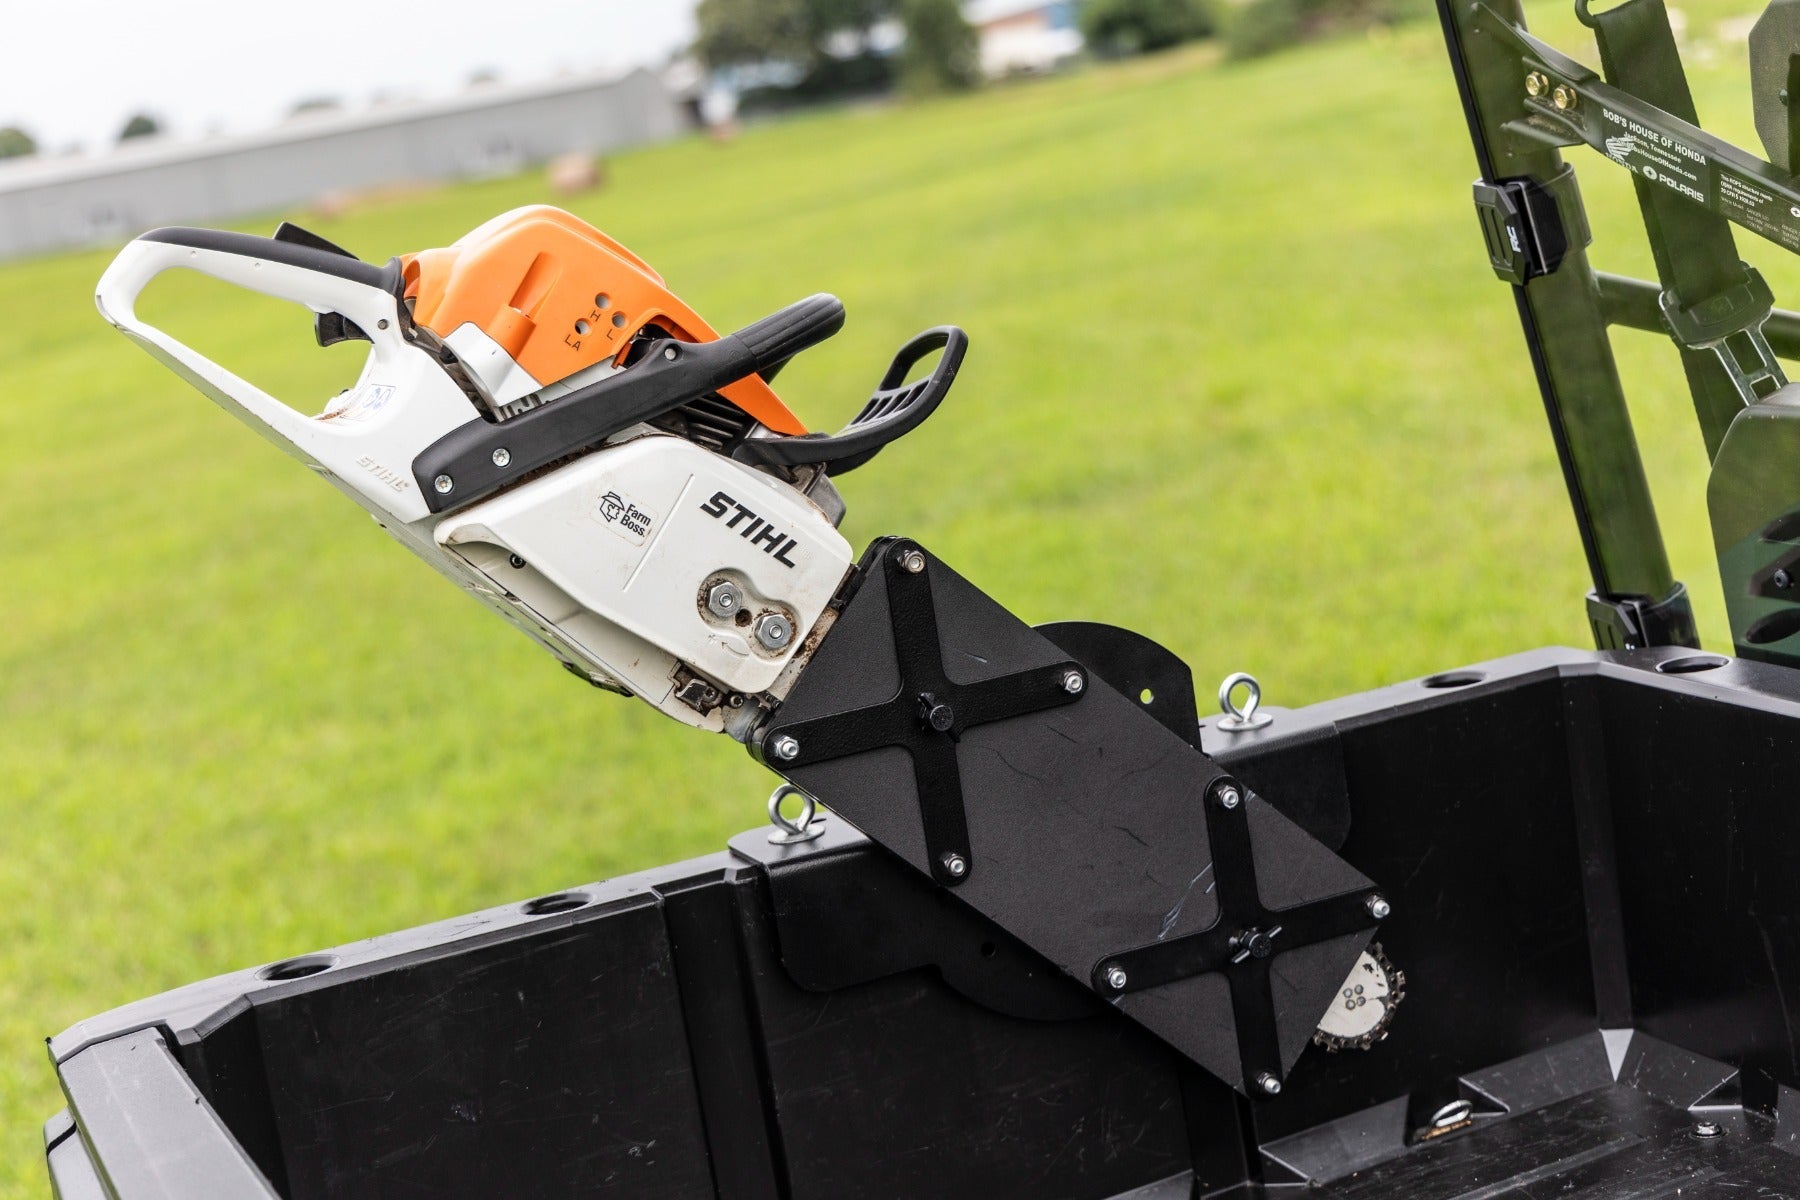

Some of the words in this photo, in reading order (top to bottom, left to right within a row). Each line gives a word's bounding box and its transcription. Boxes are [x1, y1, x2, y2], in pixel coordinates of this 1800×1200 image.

[1602, 108, 1628, 128] BOB'S
[1629, 121, 1659, 143] HOUSE
[1660, 136, 1674, 149] OF
[1674, 143, 1706, 166] HONDA
[1650, 143, 1682, 163] Tennessee
[1659, 173, 1705, 203] POLARIS
[590, 310, 601, 322] H
[564, 334, 581, 352] LA
[606, 328, 613, 341] L
[625, 503, 652, 526] Farm
[700, 491, 798, 569] STIHL
